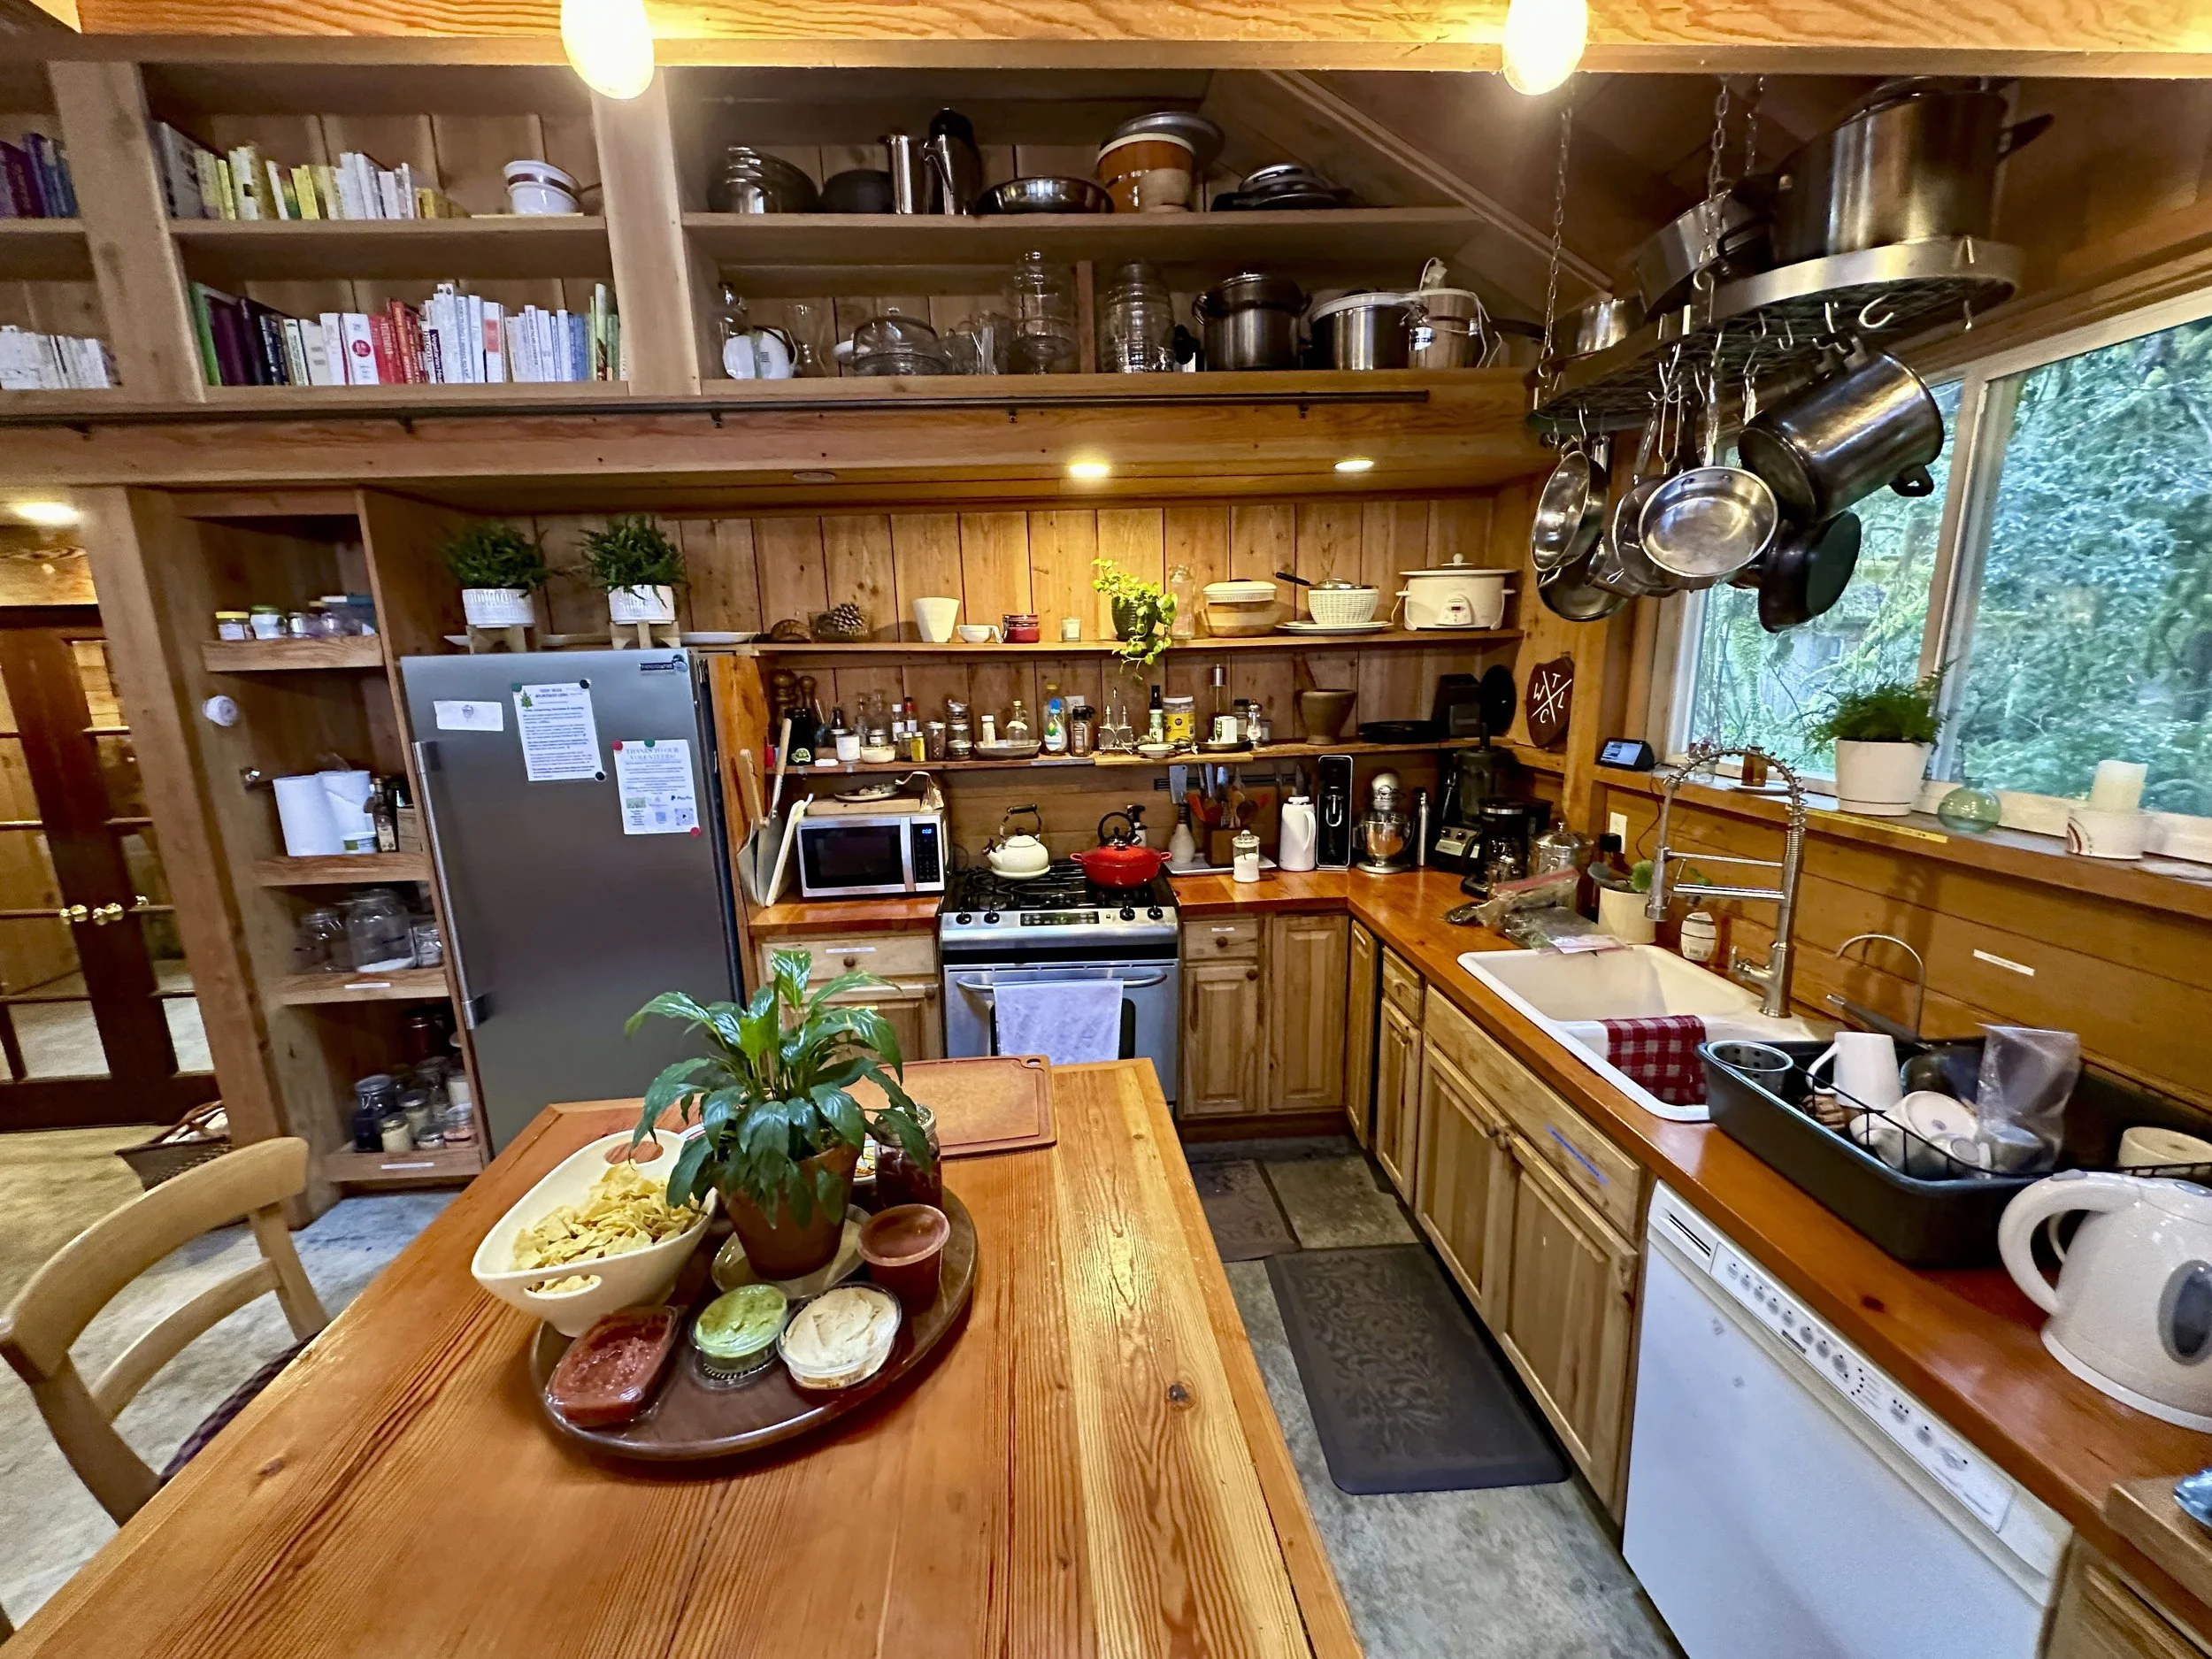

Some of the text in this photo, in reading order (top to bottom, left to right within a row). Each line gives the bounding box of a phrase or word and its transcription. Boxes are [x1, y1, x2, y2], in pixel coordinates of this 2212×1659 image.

[1552, 672, 1561, 688] T
[1532, 682, 1545, 701] W
[1557, 691, 1564, 709] L
[1540, 708, 1549, 724] C
